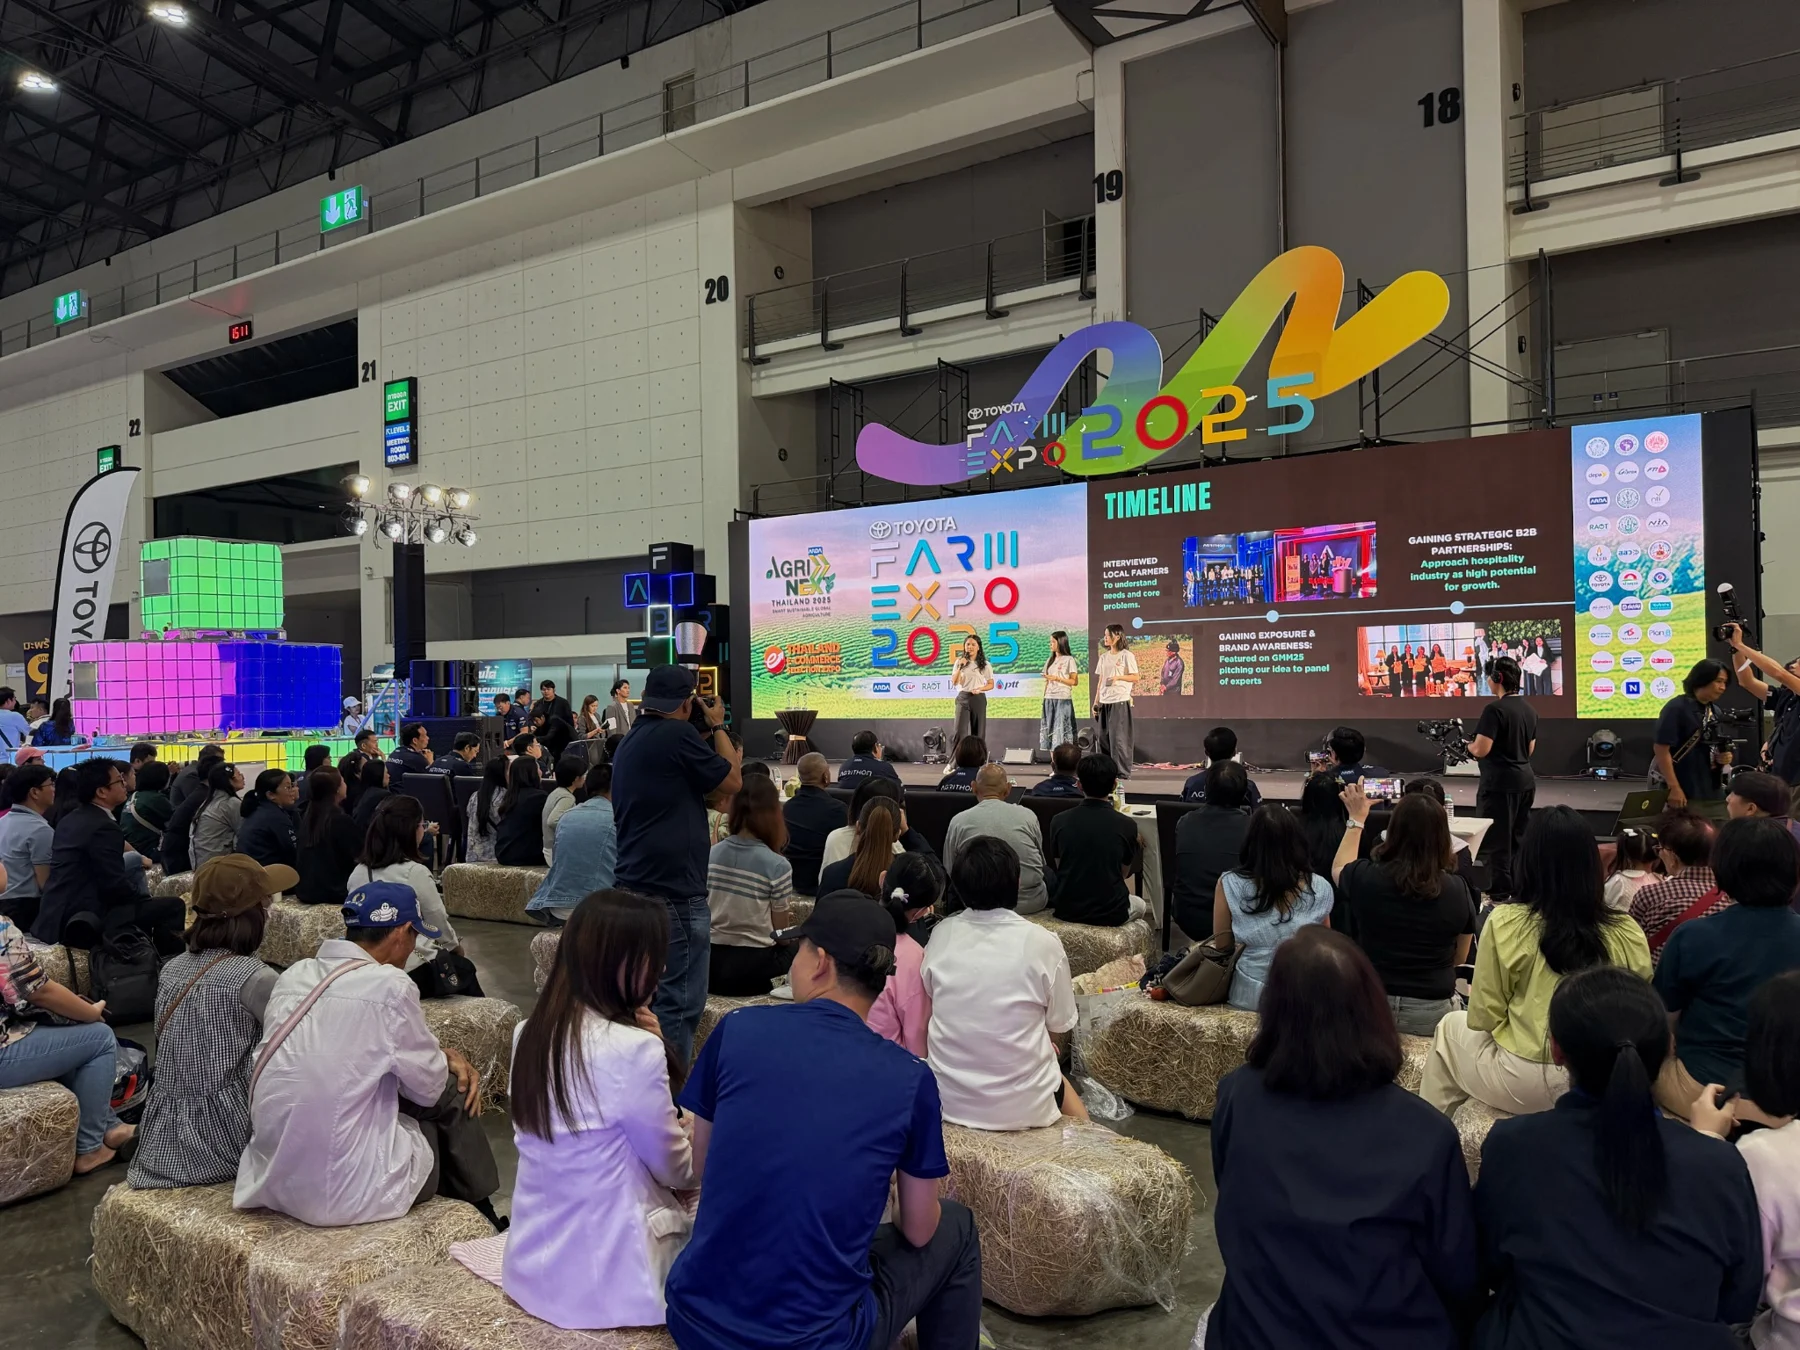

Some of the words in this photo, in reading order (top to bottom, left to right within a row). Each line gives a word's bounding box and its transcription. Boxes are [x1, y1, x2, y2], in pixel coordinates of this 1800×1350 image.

[1417, 87, 1460, 128] 18
[1092, 169, 1123, 204] 19
[705, 275, 729, 305] 20
[361, 359, 376, 383] 21
[387, 399, 407, 413] EXIT
[984, 402, 1026, 417] TOYOTA
[1081, 372, 1315, 460] 2025
[129, 418, 141, 437] 22
[390, 425, 406, 435] LEVEL
[406, 424, 411, 432] 2
[386, 437, 409, 447] MEETING
[390, 445, 407, 454] ROOM
[967, 441, 1067, 475] EXPO
[99, 462, 113, 473] EXIT
[1104, 481, 1211, 520] TIMELINE
[893, 516, 957, 536] TOYOTA
[1408, 534, 1453, 545] GAINING
[1454, 529, 1513, 541] STRATEGIC
[1516, 527, 1537, 537] B2B
[1431, 542, 1513, 555] PARTNERSHIPS:
[652, 546, 668, 570] F
[1103, 557, 1158, 568] INTERVIEWED
[1420, 557, 1468, 569] Approach
[1471, 554, 1524, 566] hospitality
[766, 556, 811, 579] AGRI
[1103, 570, 1129, 579] LOCAL
[1131, 567, 1169, 577] FARMERS
[1410, 571, 1450, 581] industry
[1466, 569, 1488, 579] high
[1490, 566, 1537, 577] potential
[786, 572, 836, 597] NEXT
[1103, 581, 1113, 589] To
[1115, 578, 1158, 588] understand
[1444, 582, 1460, 591] for
[1461, 581, 1500, 592] growth.
[871, 576, 1019, 622] EXPO
[1103, 590, 1126, 600] needs
[1127, 589, 1141, 598] and
[771, 598, 810, 608] THAILAND
[812, 596, 831, 605] 2025
[1103, 601, 1141, 611] problems.
[1219, 632, 1256, 641] GAINING
[1258, 630, 1307, 640] EXPOSURE
[1309, 629, 1316, 638] &
[23, 637, 50, 651] มะพร้
[786, 642, 841, 655] THAILAND
[871, 621, 1020, 667] 2025
[1219, 644, 1250, 652] BRAND
[1252, 641, 1313, 651] AWARENESS:
[786, 654, 841, 665] E-COMMERCE
[1219, 655, 1257, 663] Featured
[1272, 653, 1304, 662] GMM25
[1219, 665, 1254, 675] pitching
[1272, 665, 1291, 673] idea
[1305, 664, 1330, 673] panel
[873, 683, 890, 691] ARDA
[922, 682, 941, 691] RAOT
[1004, 680, 1020, 689] ptt
[1219, 677, 1229, 685] of
[1230, 677, 1262, 686] experts
[1629, 683, 1637, 692] N
